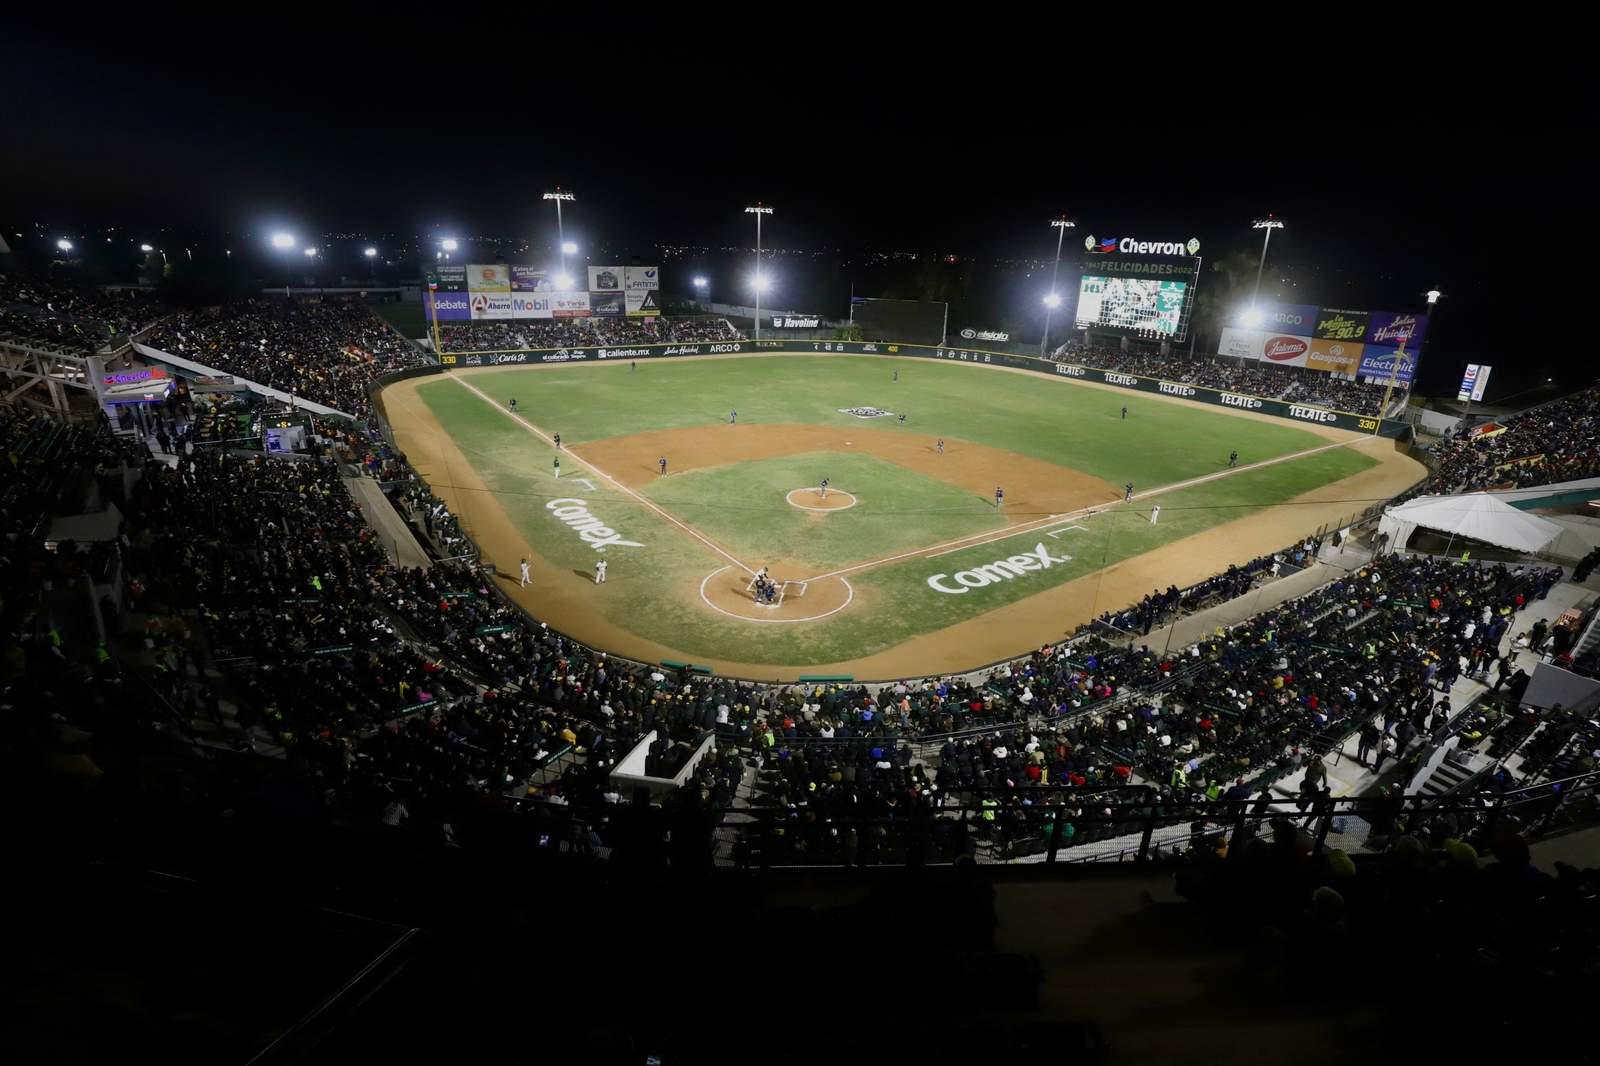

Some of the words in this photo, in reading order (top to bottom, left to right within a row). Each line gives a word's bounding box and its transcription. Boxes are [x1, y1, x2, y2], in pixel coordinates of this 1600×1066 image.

[1119, 237, 1185, 255] Chevron
[1100, 261, 1174, 274] FELICIDADES
[434, 300, 468, 310] debate
[513, 298, 549, 311] Mobil
[783, 318, 819, 328] Havoline
[1336, 326, 1365, 339] 90.9
[606, 349, 650, 358] caliente.mx
[710, 344, 733, 353] ARCO
[442, 356, 457, 364] 330
[1055, 363, 1080, 376] TECATE
[1104, 372, 1132, 385] TECATE
[1158, 381, 1189, 396] TECATE
[1220, 392, 1255, 408] TECATE
[1289, 404, 1329, 422] TECATE
[1358, 418, 1376, 430] 330
[545, 497, 646, 550] Comex
[927, 541, 1066, 595] Comex
